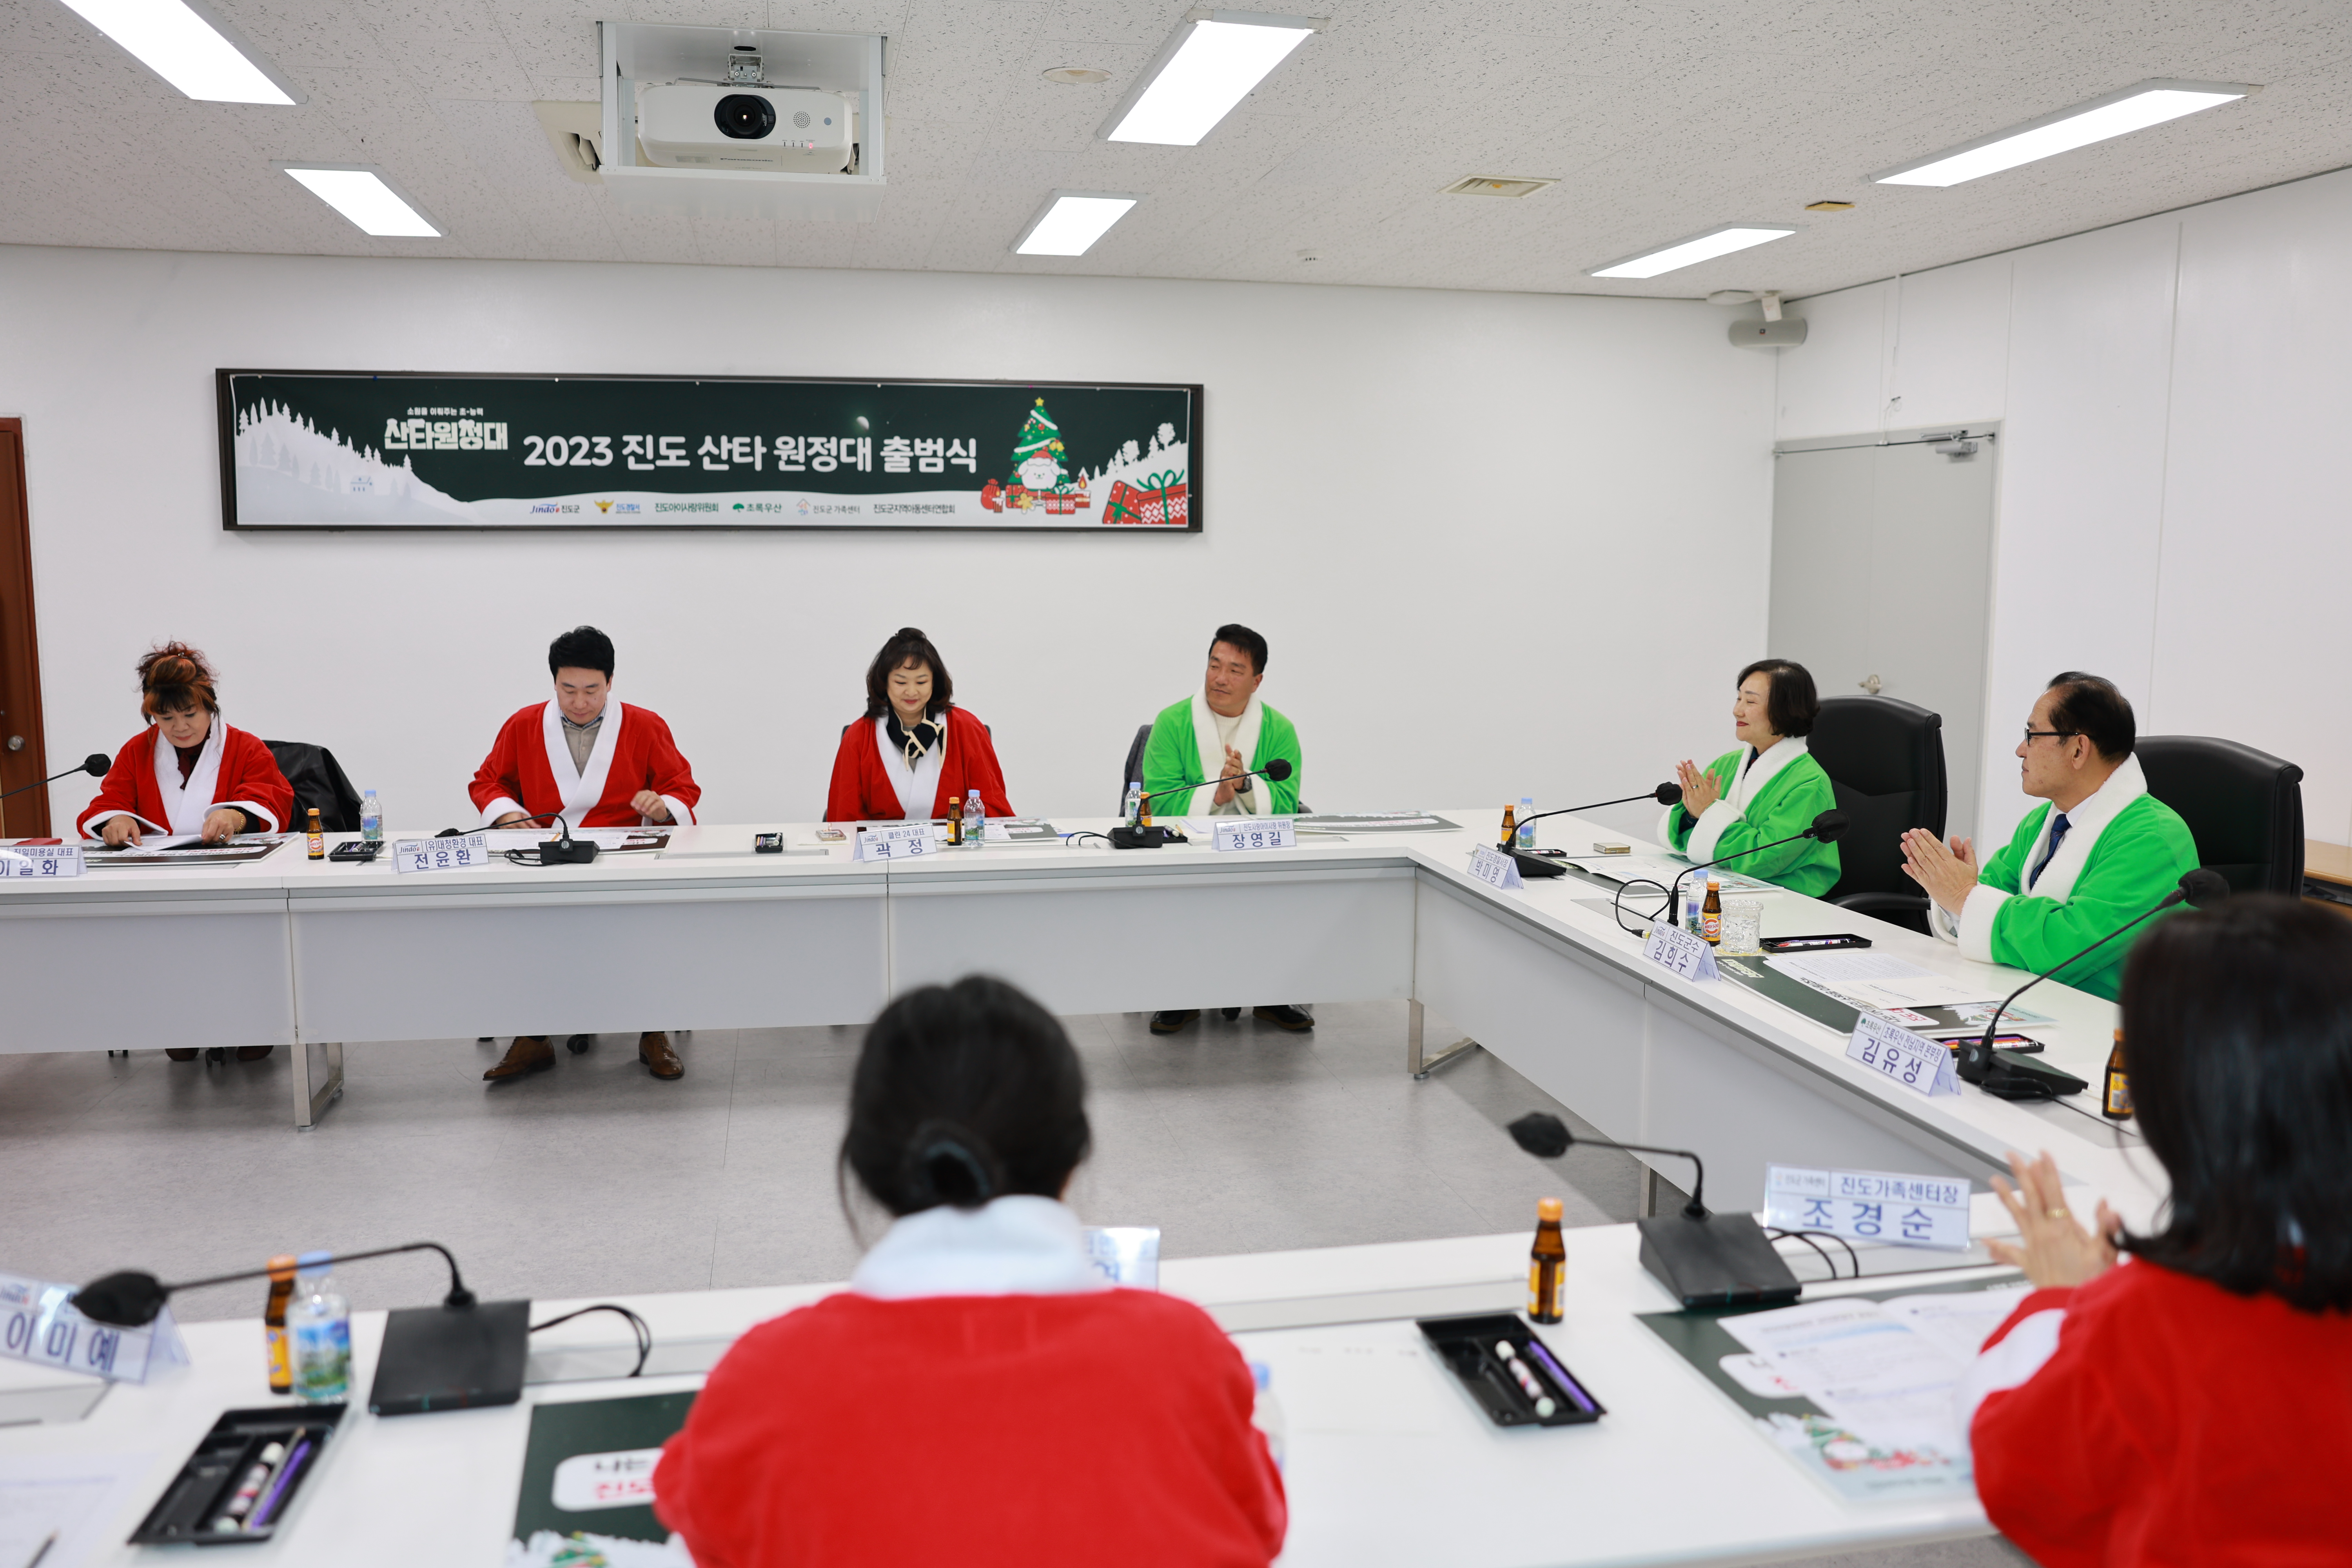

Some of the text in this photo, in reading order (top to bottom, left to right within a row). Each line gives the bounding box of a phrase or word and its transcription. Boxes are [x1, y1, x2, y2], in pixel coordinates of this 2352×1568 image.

[384, 418, 508, 450] 산타원정대
[523, 434, 977, 474] 2023 진도 산타 원정대 출범식
[530, 504, 580, 514] Jindo 진도군
[655, 503, 719, 513] 진도아이사랑위원회
[746, 503, 782, 513] 초록우산
[813, 505, 860, 514] 진도군 가족센터
[873, 503, 955, 514] 진도군지역아동센터연합회
[1278, 821, 1290, 829] 위원장
[888, 831, 901, 839] 클린
[1232, 831, 1281, 849] 장영길
[14, 848, 73, 857] 진일미용실 대표
[399, 836, 483, 854] Jindo (유)대청환경 대표
[414, 849, 471, 870] 전윤환
[1486, 851, 1509, 868] 진도경찰서장
[1475, 859, 1500, 883] 박미영
[1669, 930, 1699, 953] 진도군수
[1653, 940, 1689, 973] 김희수
[1865, 1020, 1942, 1062] 초록우산 초록우산 전남지역 본부장
[1862, 1037, 1922, 1083] 김유성
[1841, 1176, 1958, 1205] 진도가족센터장
[1802, 1198, 1933, 1242] 조경순
